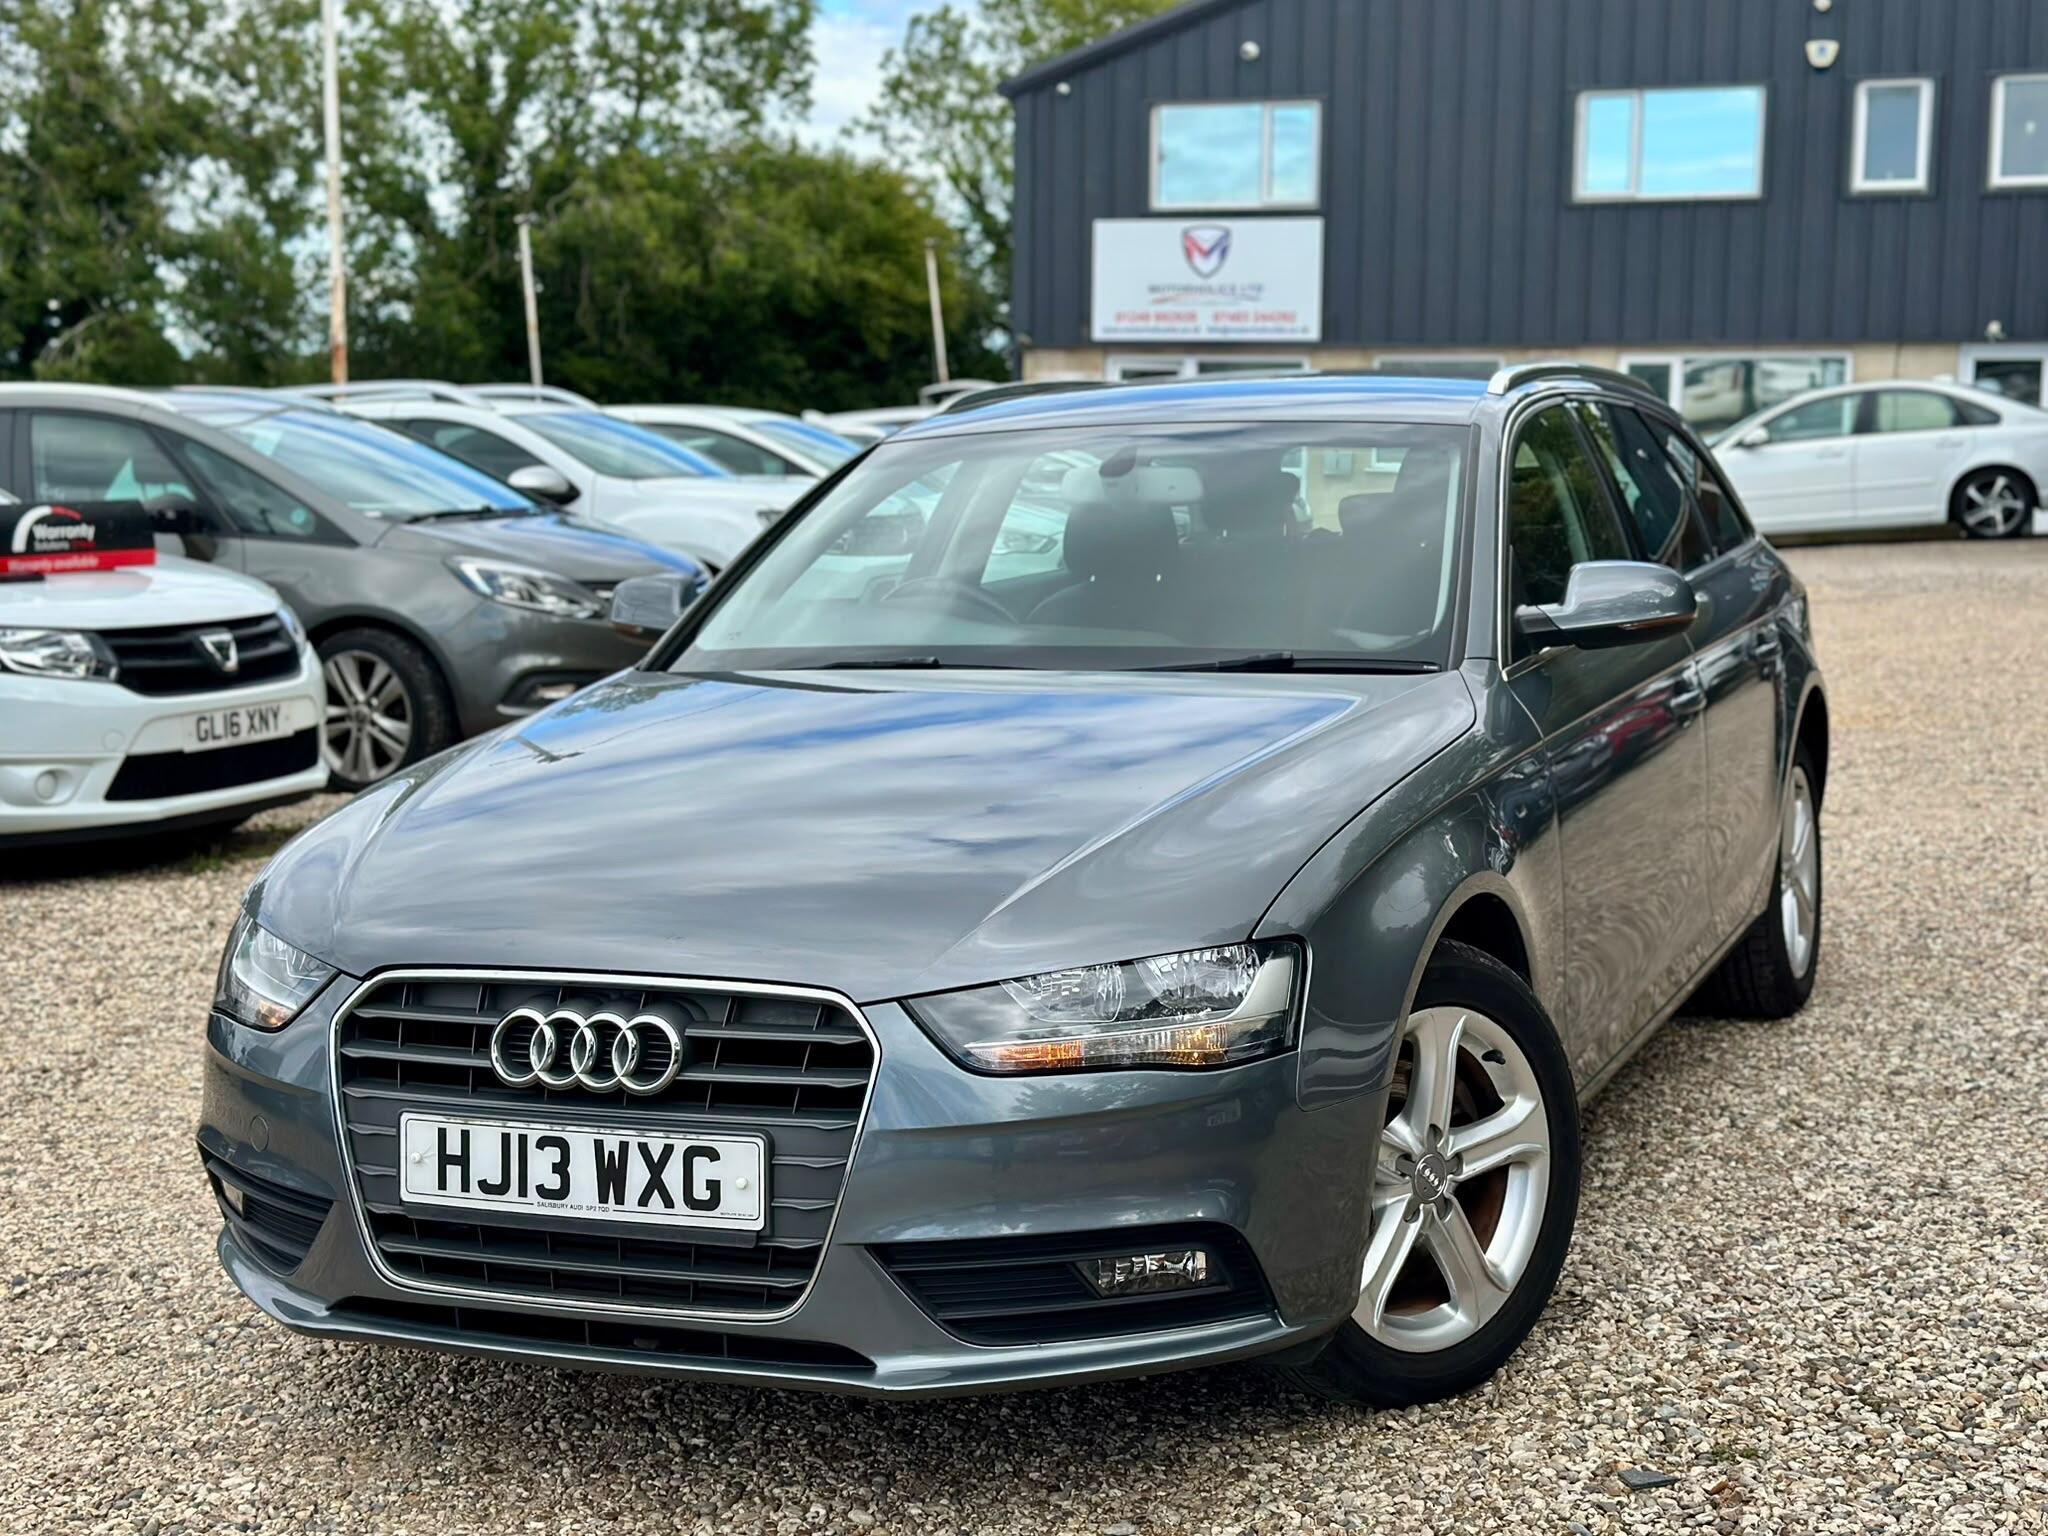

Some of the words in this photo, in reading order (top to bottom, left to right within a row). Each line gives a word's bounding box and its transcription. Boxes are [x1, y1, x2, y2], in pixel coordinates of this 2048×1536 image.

[32, 522, 96, 541] Warranty
[197, 711, 241, 742] GL16
[246, 703, 281, 735] XNY
[437, 1127, 571, 1201] HJ13
[593, 1138, 721, 1211] WXG
[536, 1201, 568, 1209] SALISBURY
